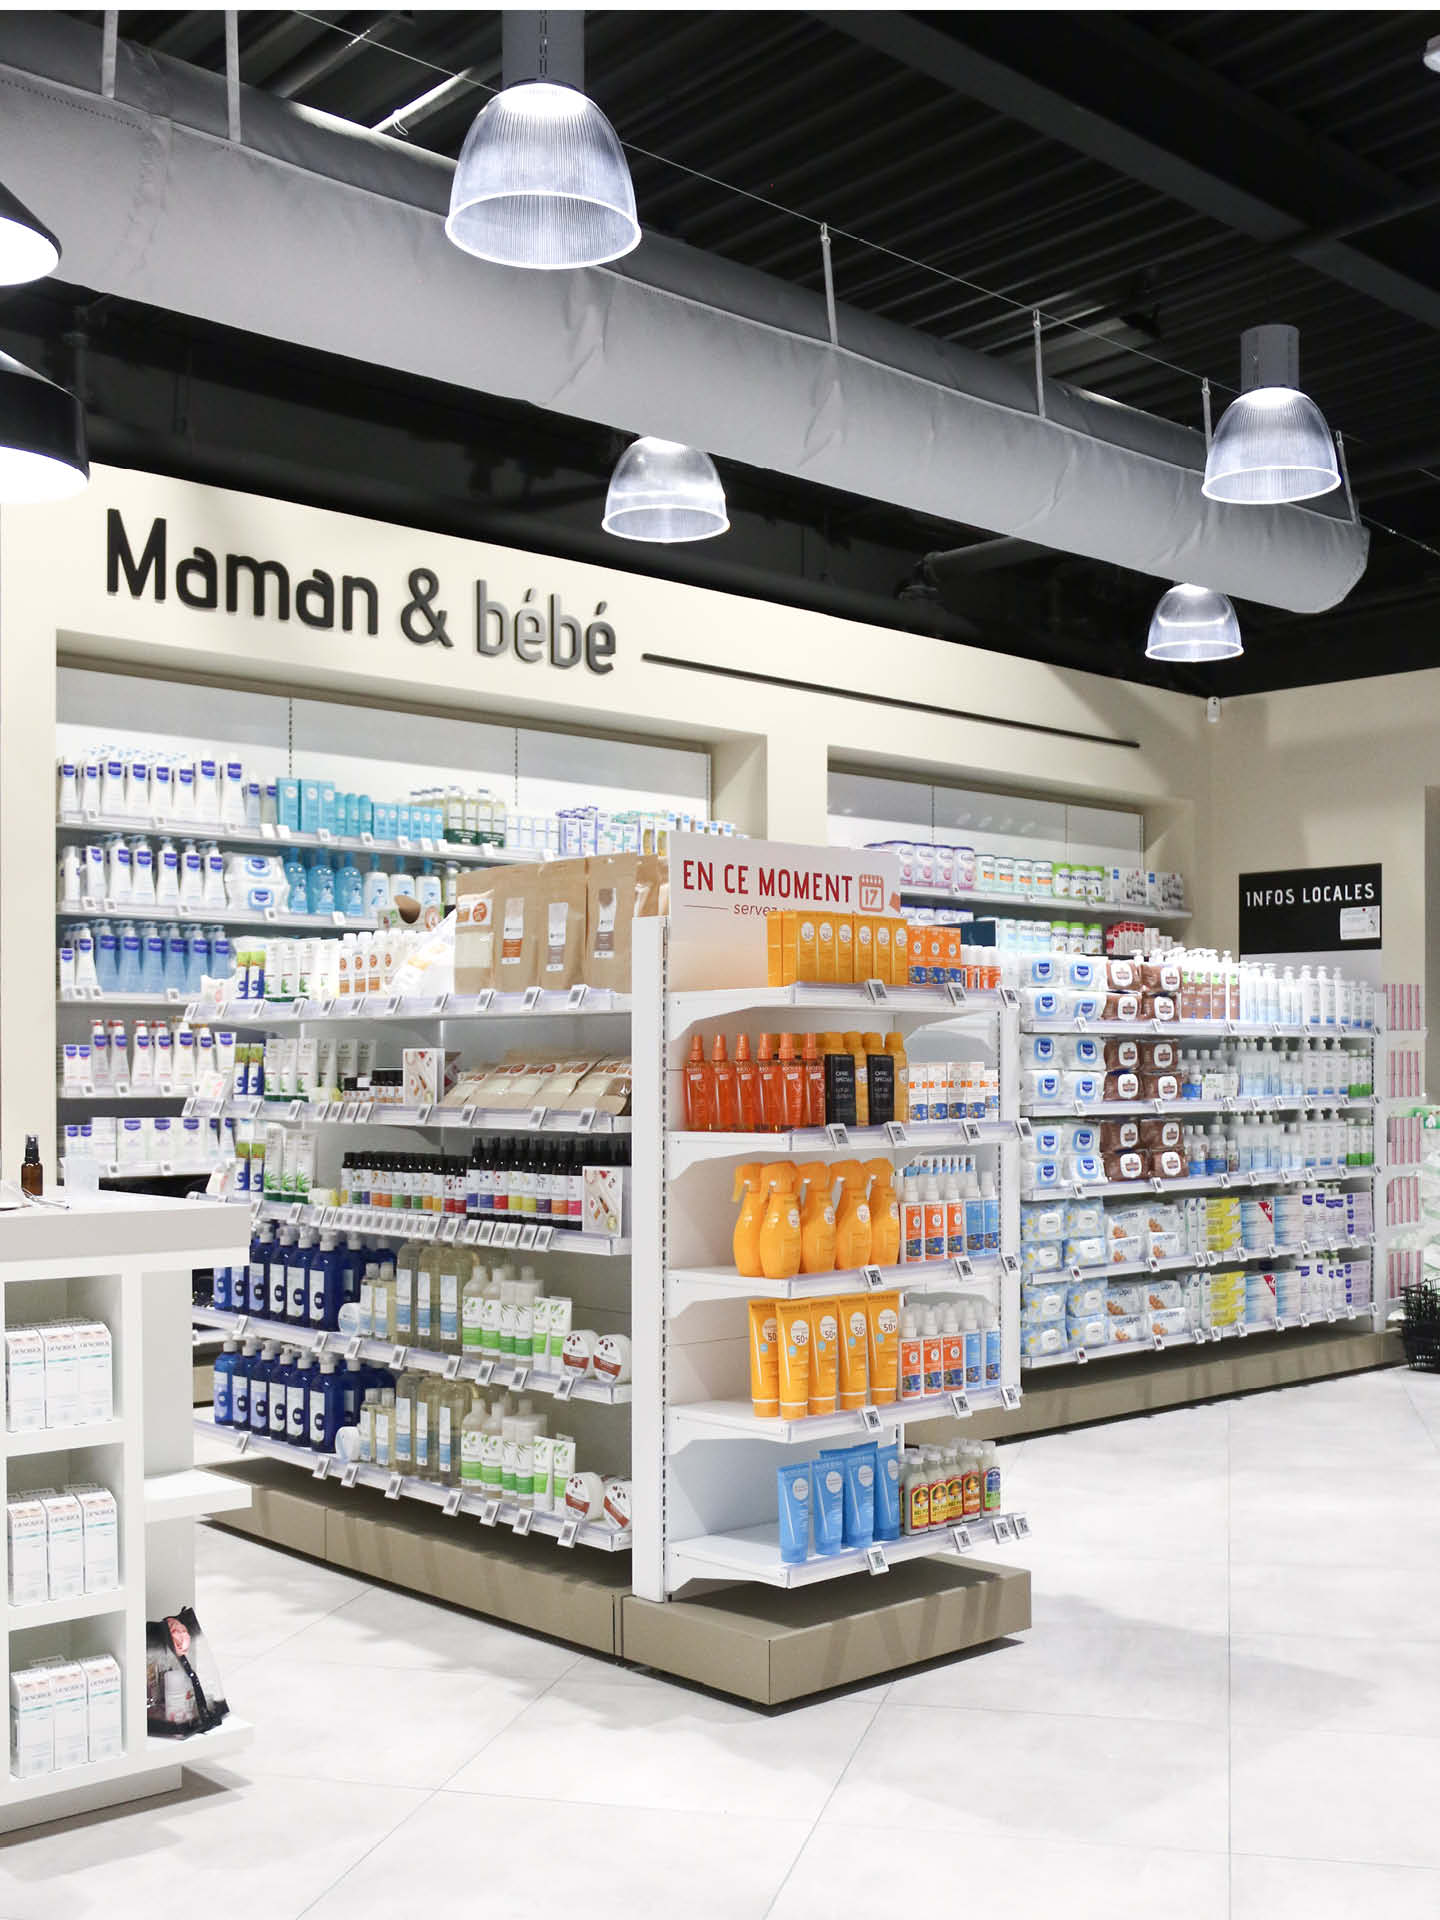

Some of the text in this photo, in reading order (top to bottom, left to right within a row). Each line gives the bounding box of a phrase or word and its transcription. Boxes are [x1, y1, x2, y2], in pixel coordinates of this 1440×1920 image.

[106, 508, 617, 674] Maman & bébé
[683, 859, 853, 903] EN CE MOMENT
[864, 888, 879, 906] 17
[1246, 883, 1375, 907] INFOS LOCALES
